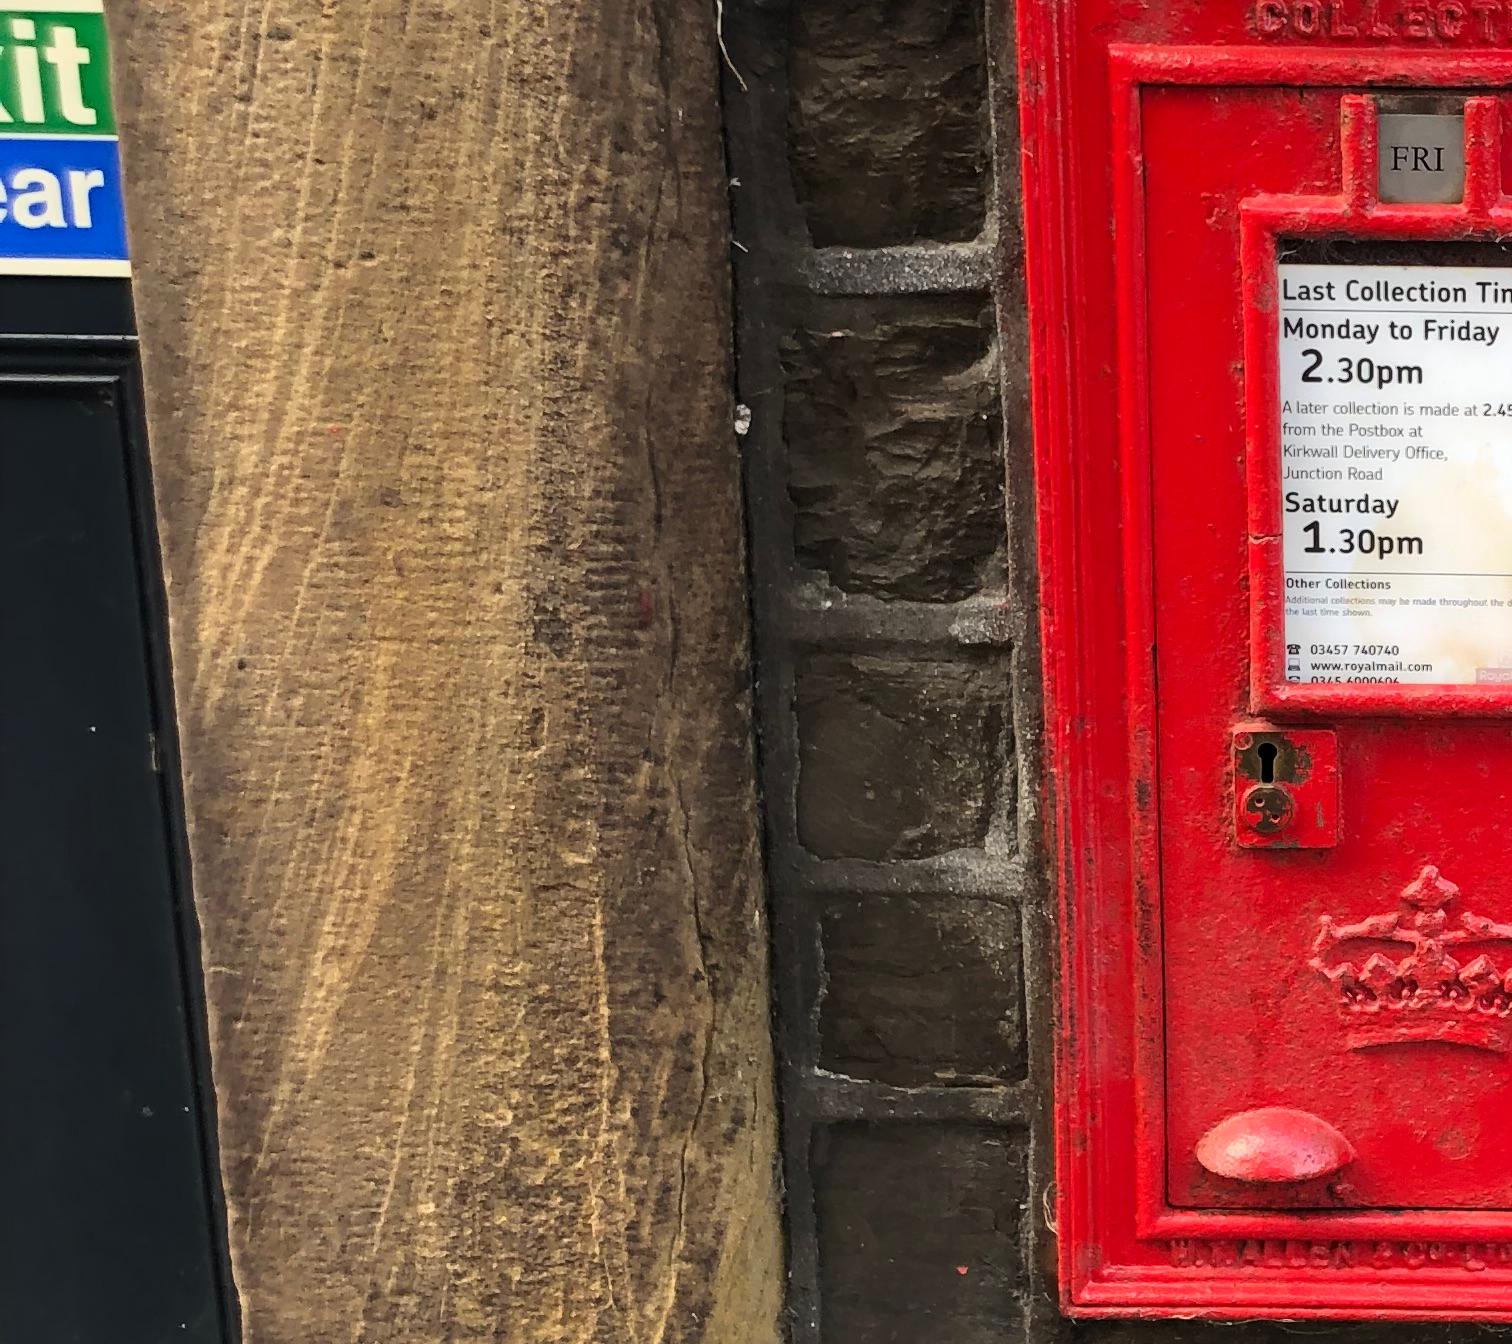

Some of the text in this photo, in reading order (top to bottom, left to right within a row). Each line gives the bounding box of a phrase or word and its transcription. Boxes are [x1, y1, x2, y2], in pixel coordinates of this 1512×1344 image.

[0, 17, 97, 125] it
[1390, 145, 1444, 173] FRI
[0, 167, 104, 229] ar
[1283, 279, 1336, 301] Last
[1346, 280, 1467, 303] Collection
[1283, 317, 1500, 345] Monday to Friday
[1301, 349, 1423, 390] 2.30pm
[1282, 401, 1292, 413] A
[1296, 401, 1327, 414] later
[1333, 403, 1399, 416] collection
[1403, 403, 1414, 416] is
[1420, 404, 1459, 417] made
[1464, 406, 1478, 417] at
[1282, 423, 1423, 437] from the Postbox at
[1283, 445, 1448, 462] Kirkwall Delivery Office,
[1283, 467, 1383, 480] Junction Road
[1285, 492, 1399, 519] Saturday
[1302, 520, 1423, 559] 1.30pm
[1286, 578, 1391, 589] Other Collections
[1285, 595, 1328, 604] Additional
[1331, 597, 1376, 605] collections
[1378, 598, 1396, 606] may
[1412, 598, 1436, 606] made
[1439, 598, 1488, 608] throughout
[1491, 599, 1504, 607] the
[1286, 608, 1299, 616] the
[1302, 608, 1317, 616] last
[1320, 608, 1339, 616] time
[1310, 645, 1399, 655] 03457 740740
[1311, 661, 1433, 673] www.royalmail.com
